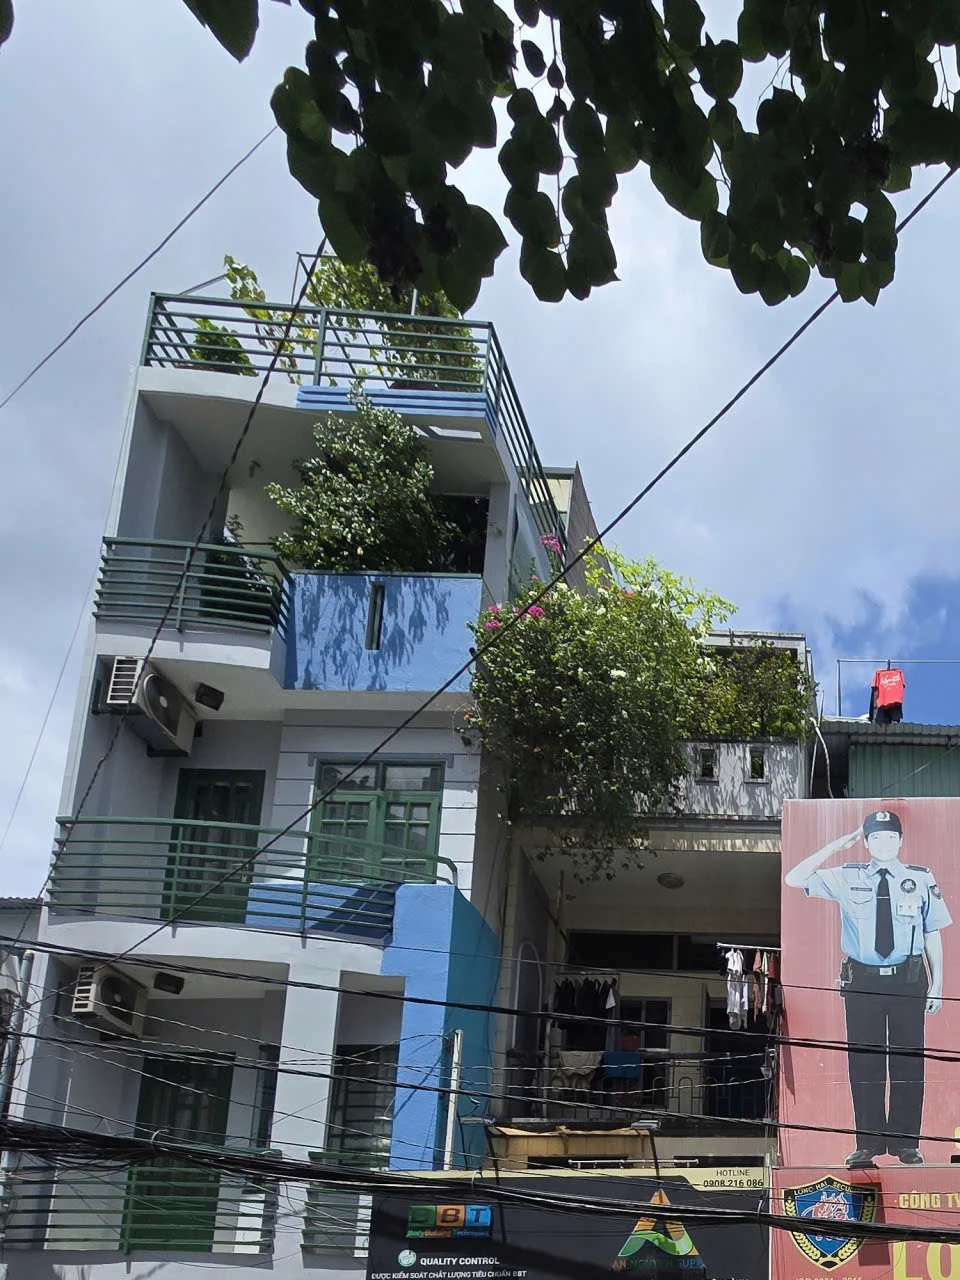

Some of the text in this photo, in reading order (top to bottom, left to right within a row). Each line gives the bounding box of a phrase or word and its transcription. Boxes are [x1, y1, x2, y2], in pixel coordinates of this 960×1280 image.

[715, 1169, 750, 1177] HOTLINE
[746, 1178, 764, 1187] 086
[899, 1189, 941, 1209] CÔNG
[419, 1257, 500, 1266] QUALITY CONTROL
